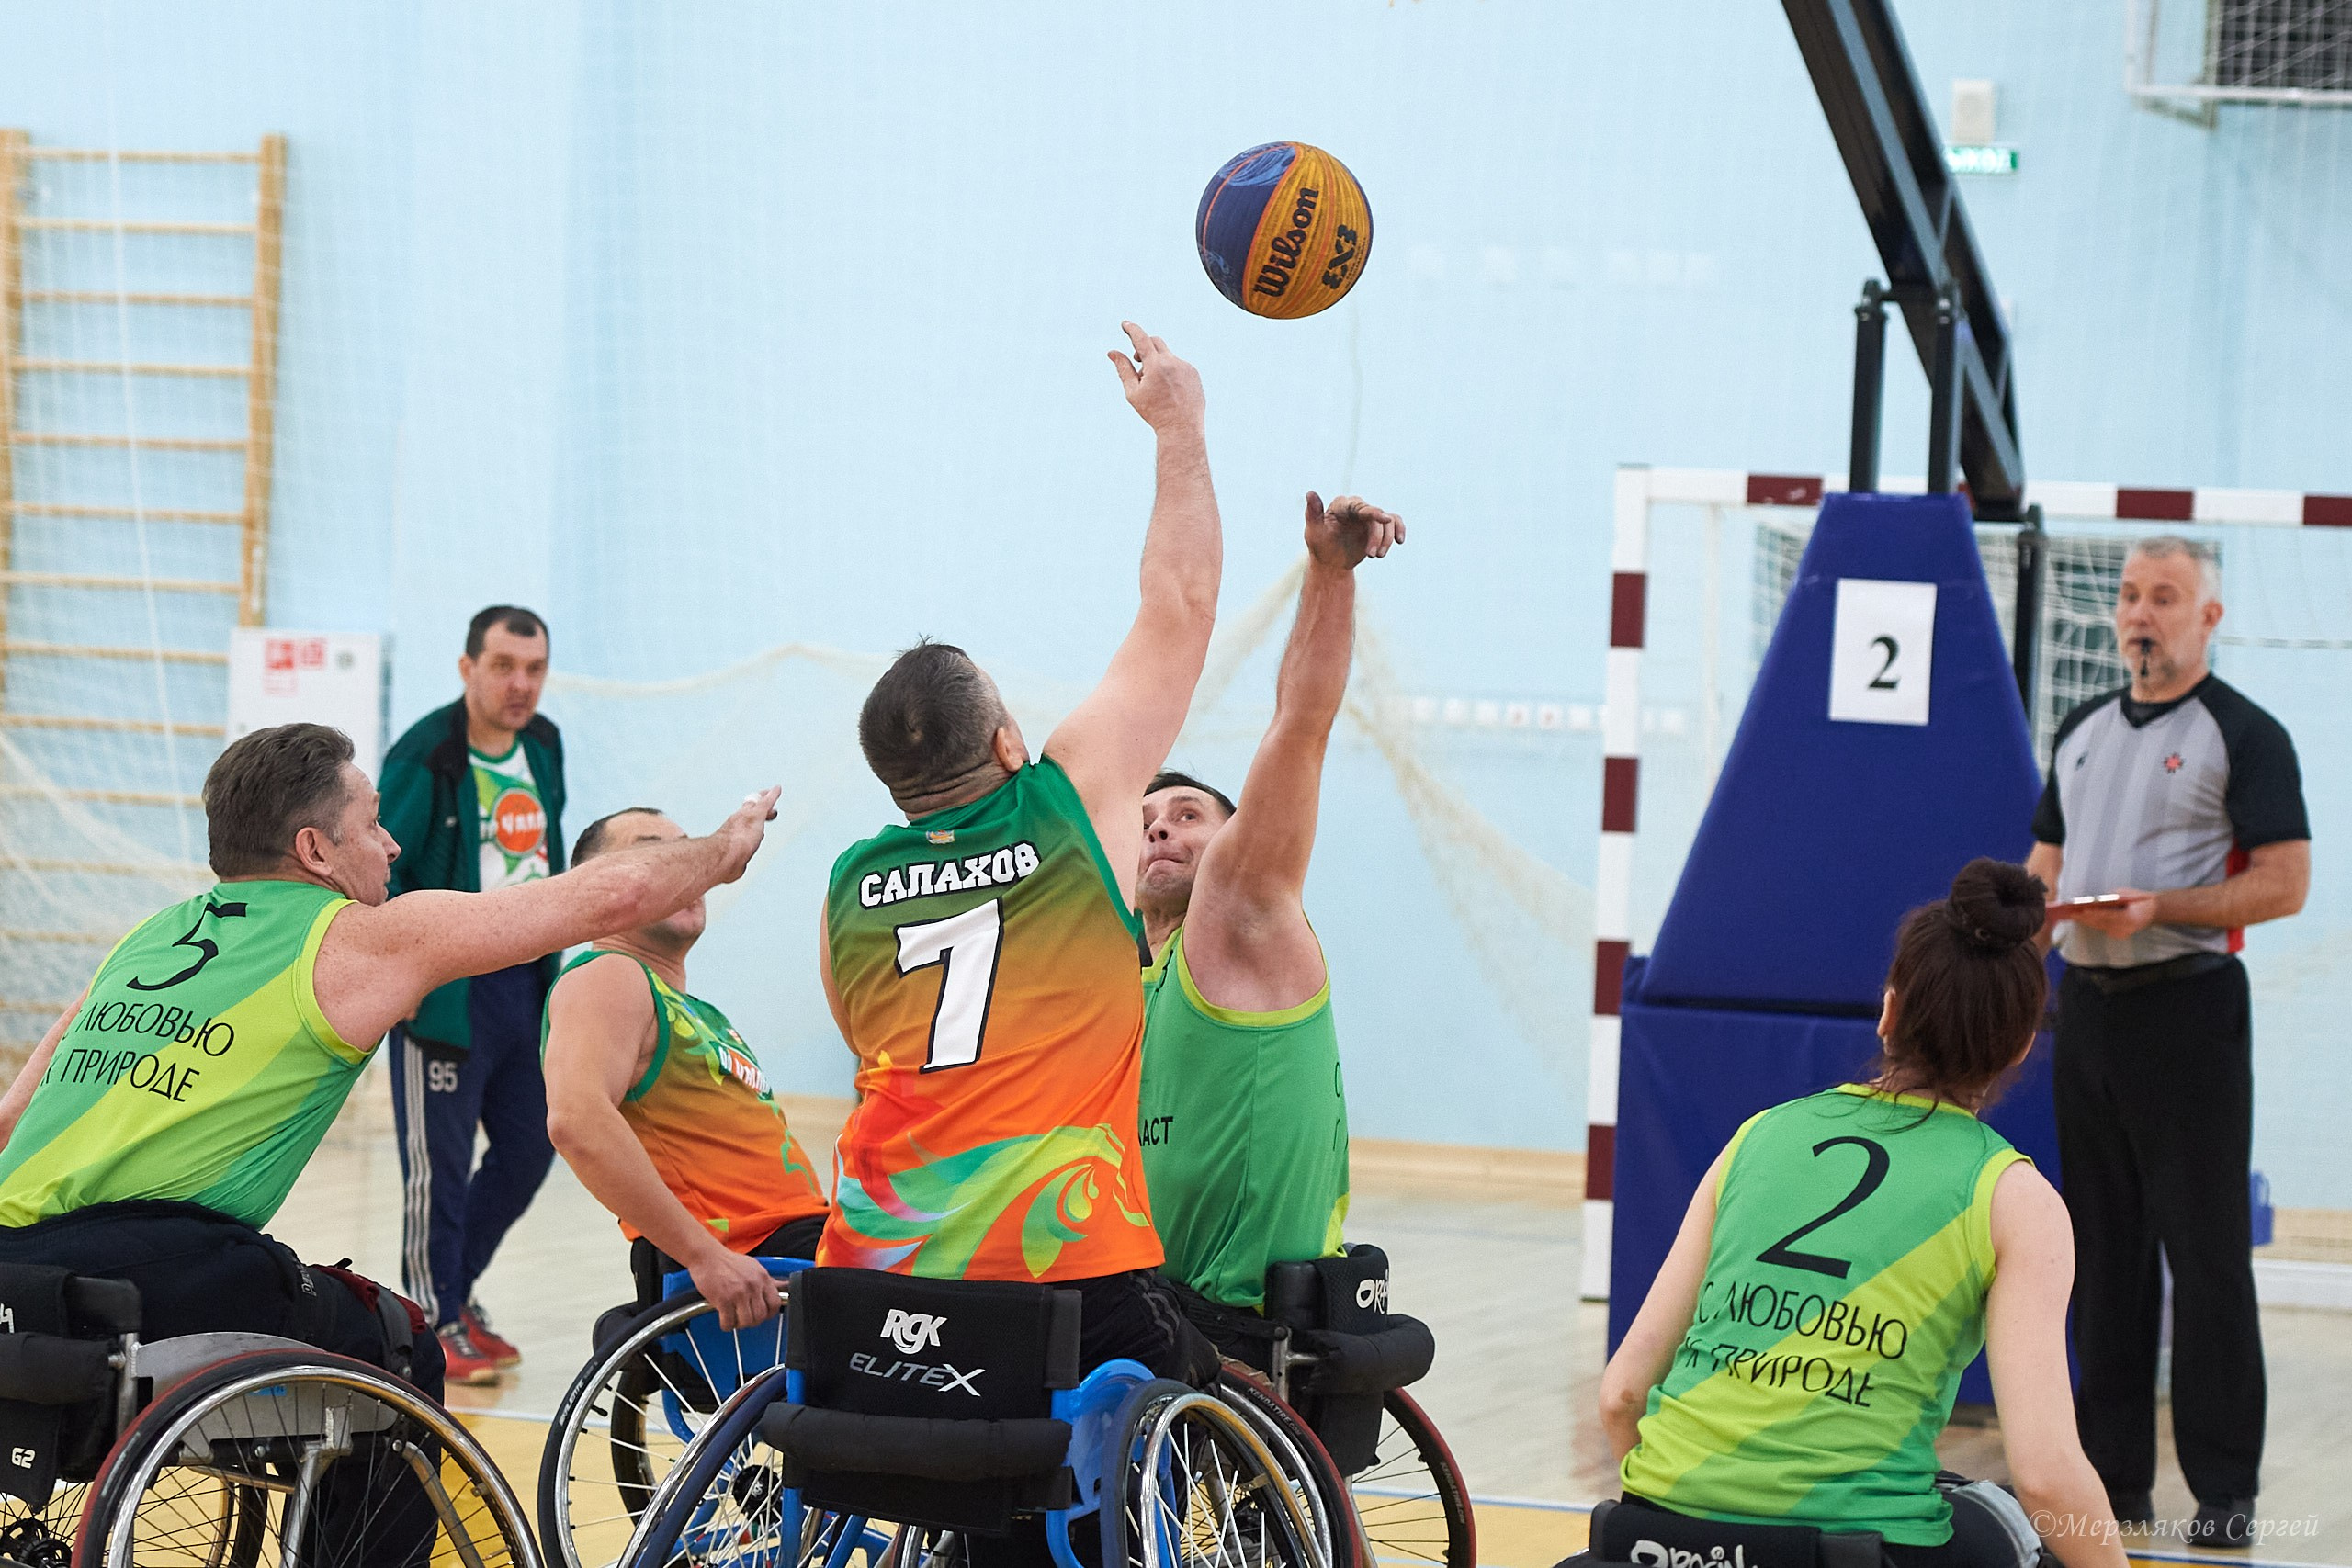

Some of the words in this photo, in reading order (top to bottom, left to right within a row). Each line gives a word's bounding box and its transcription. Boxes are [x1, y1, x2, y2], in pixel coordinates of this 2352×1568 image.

[1253, 187, 1319, 297] Wilson
[1869, 634, 1901, 690] 2
[860, 840, 1042, 909] САЛАХОВ
[126, 902, 248, 991] 5
[895, 897, 1004, 1073] 7
[75, 1001, 235, 1057] ЛЮБОВЬЮ
[59, 1048, 200, 1103] ПРИРОДЕ
[428, 1060, 458, 1093] 95
[1756, 1135, 1891, 1280] 2
[879, 1308, 948, 1355] RGK
[1713, 1281, 1908, 1360] ЛЮБОВЬЮ
[1711, 1343, 1875, 1408] ПРИРОДЕ
[11, 1447, 36, 1470] G2
